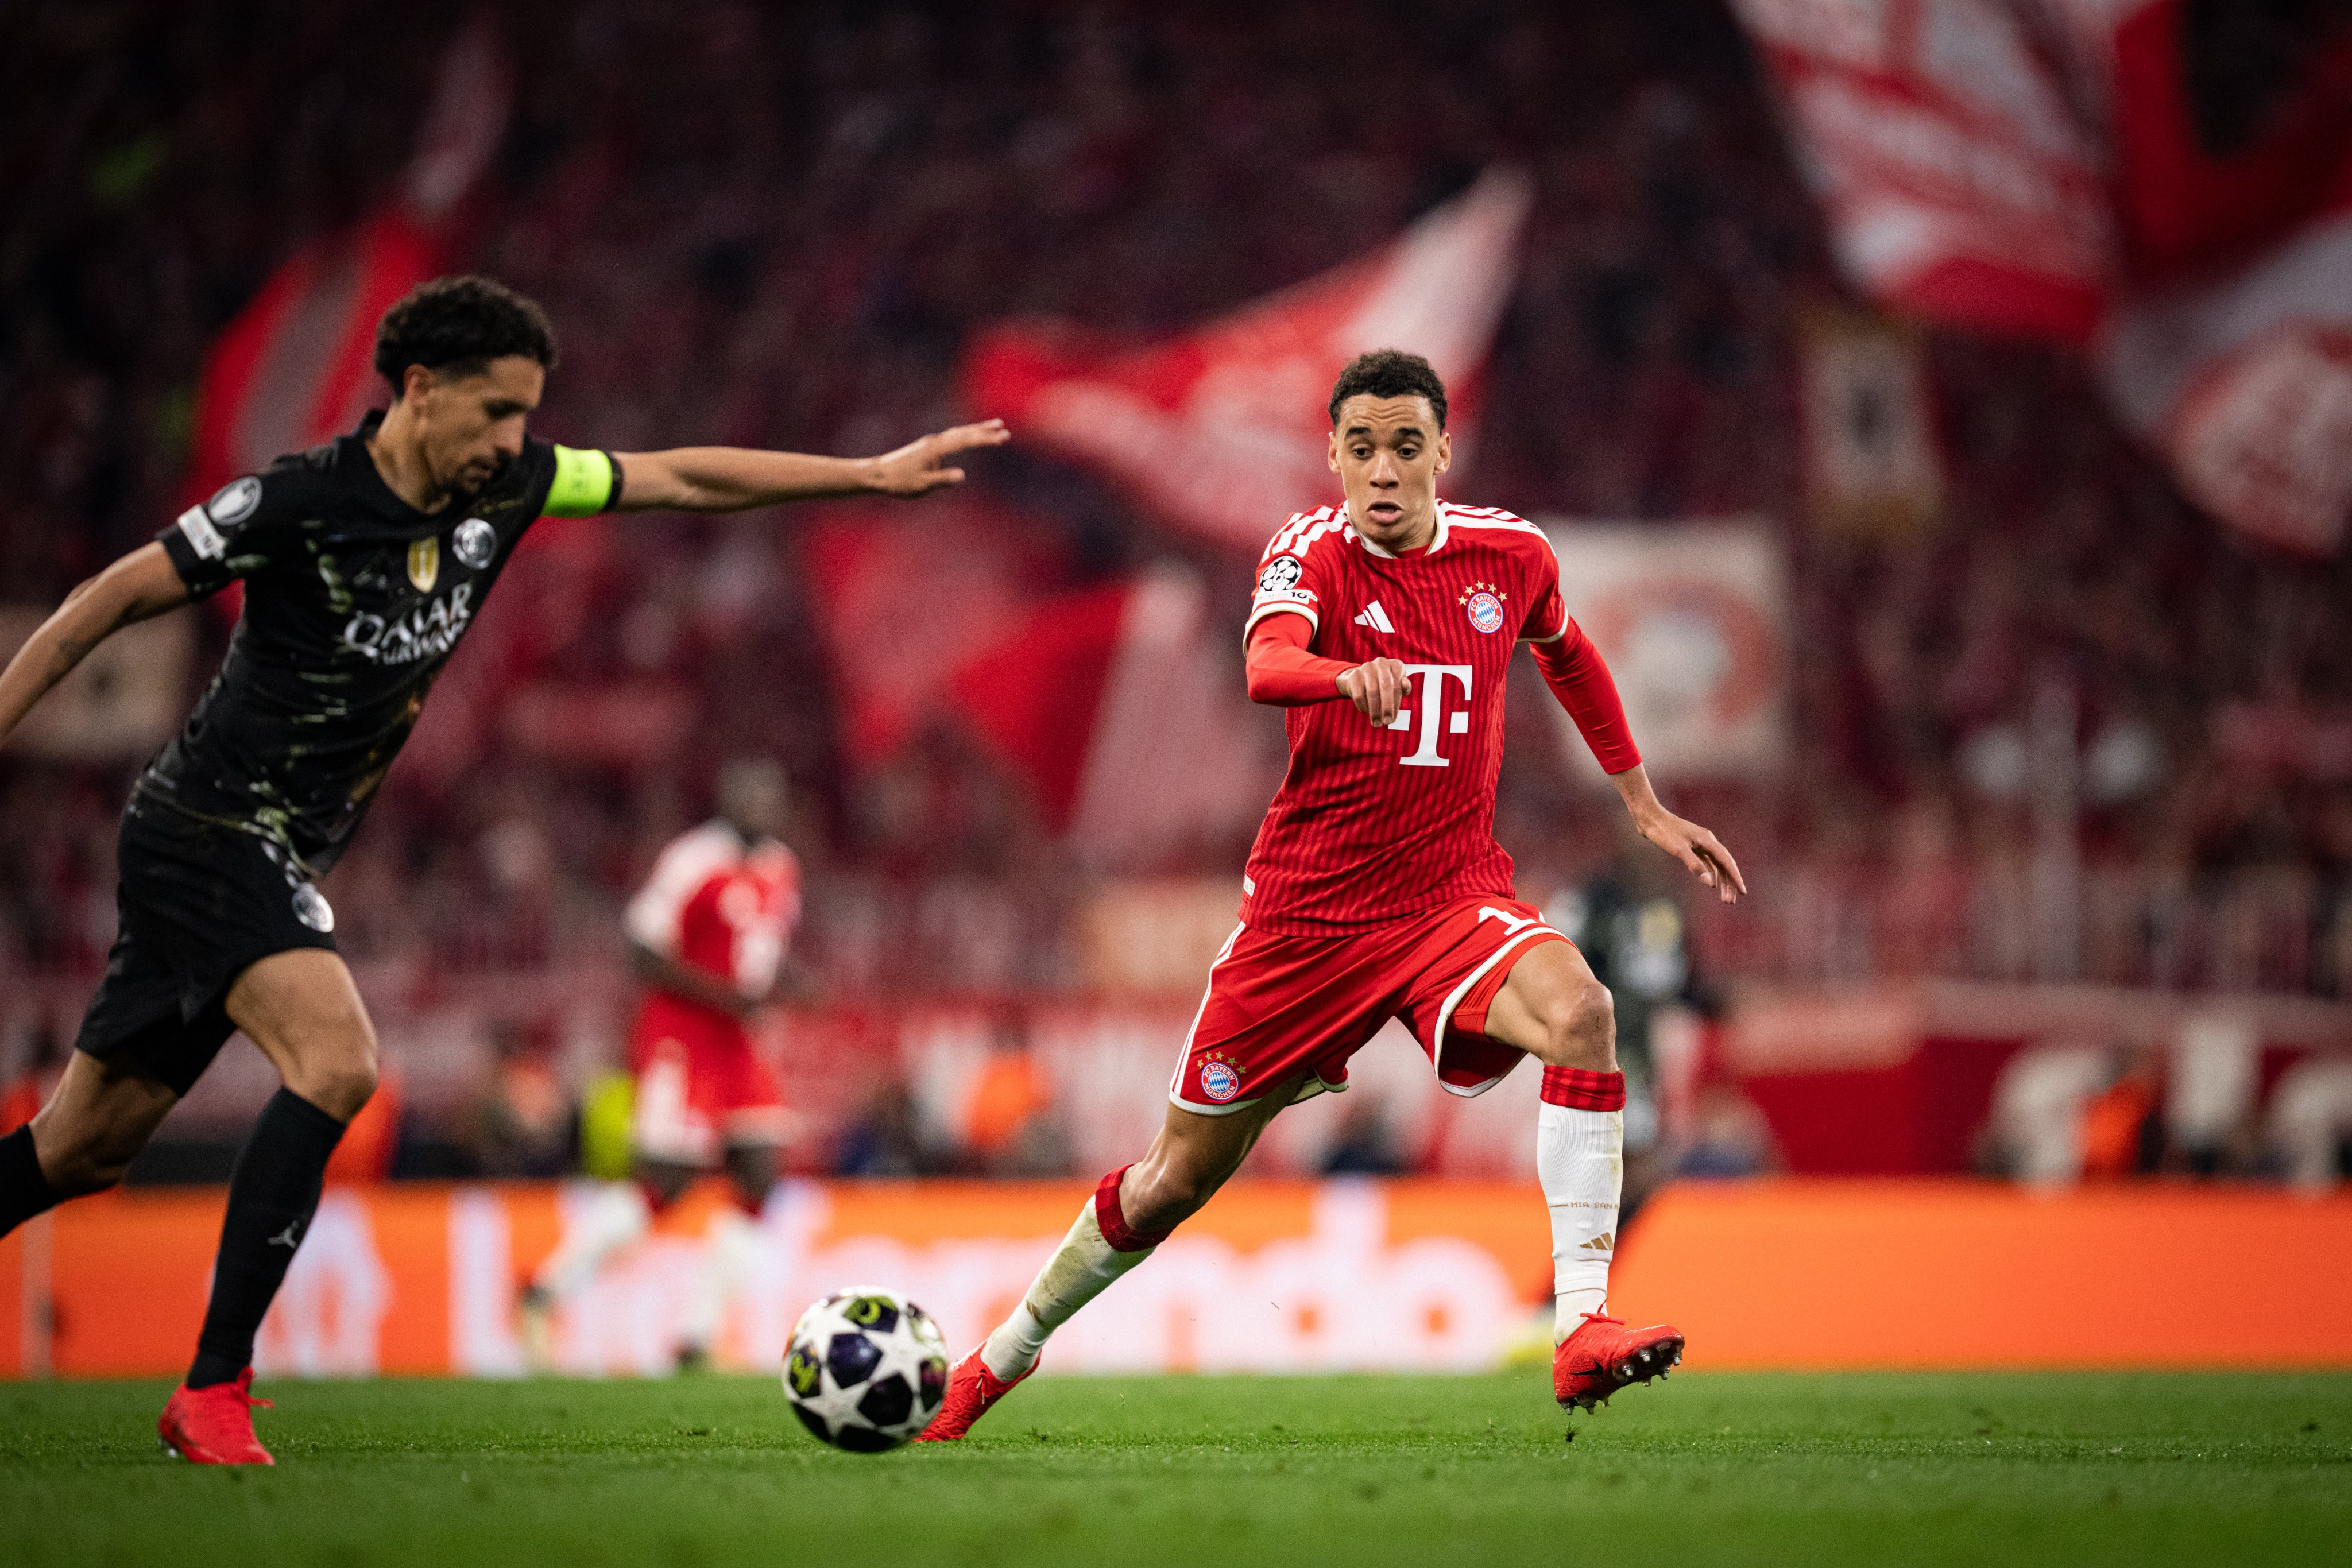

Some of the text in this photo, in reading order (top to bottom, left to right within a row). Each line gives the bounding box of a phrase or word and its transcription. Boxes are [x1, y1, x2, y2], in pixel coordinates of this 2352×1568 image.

[1470, 595, 1499, 611] FC BAYERN
[1388, 664, 1472, 767] T
[1204, 1065, 1235, 1081] FC BAYERN
